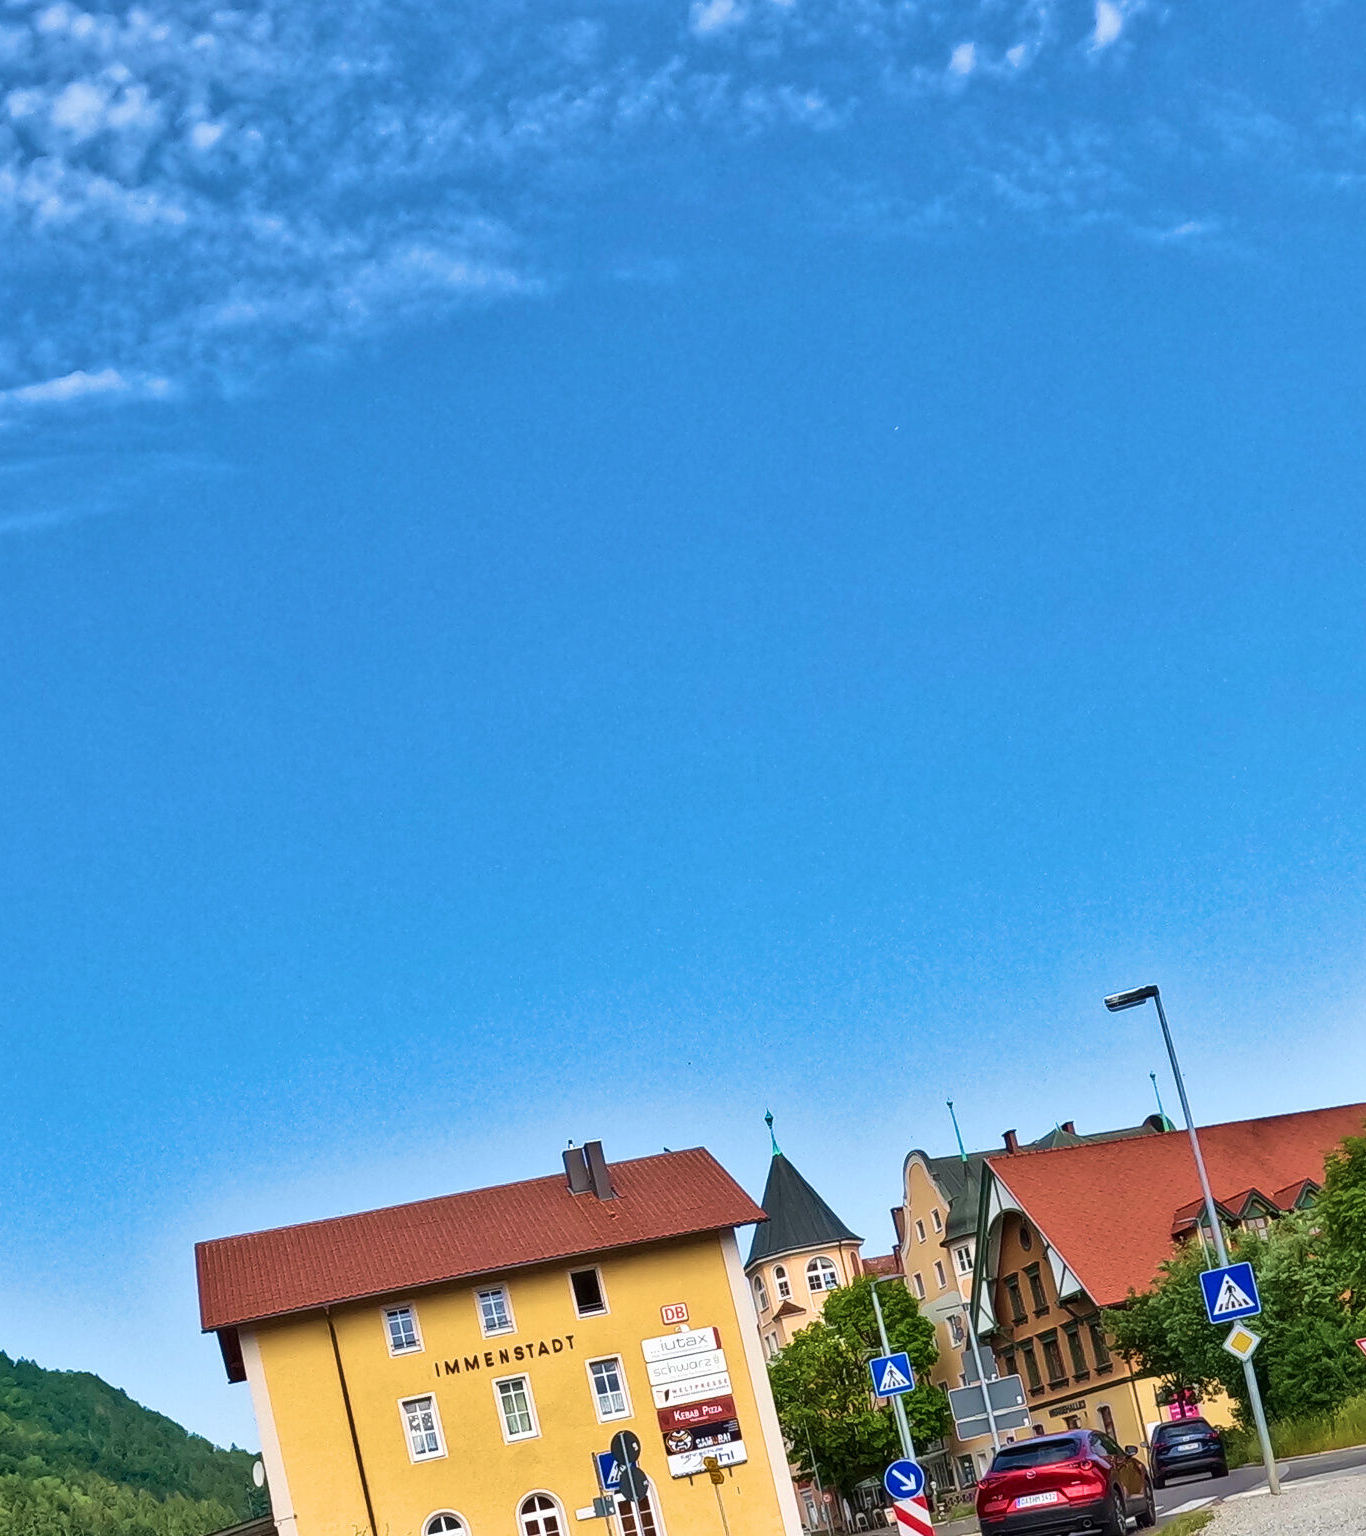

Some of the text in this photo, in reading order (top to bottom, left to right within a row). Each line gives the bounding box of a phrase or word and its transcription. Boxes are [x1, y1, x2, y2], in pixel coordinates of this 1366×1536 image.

[664, 1306, 686, 1321] DB
[434, 1335, 575, 1378] IMMENSTADT
[653, 1357, 713, 1378] schwarz
[672, 1378, 729, 1394] WELTPRESSE
[695, 1432, 732, 1449] SAMURAI
